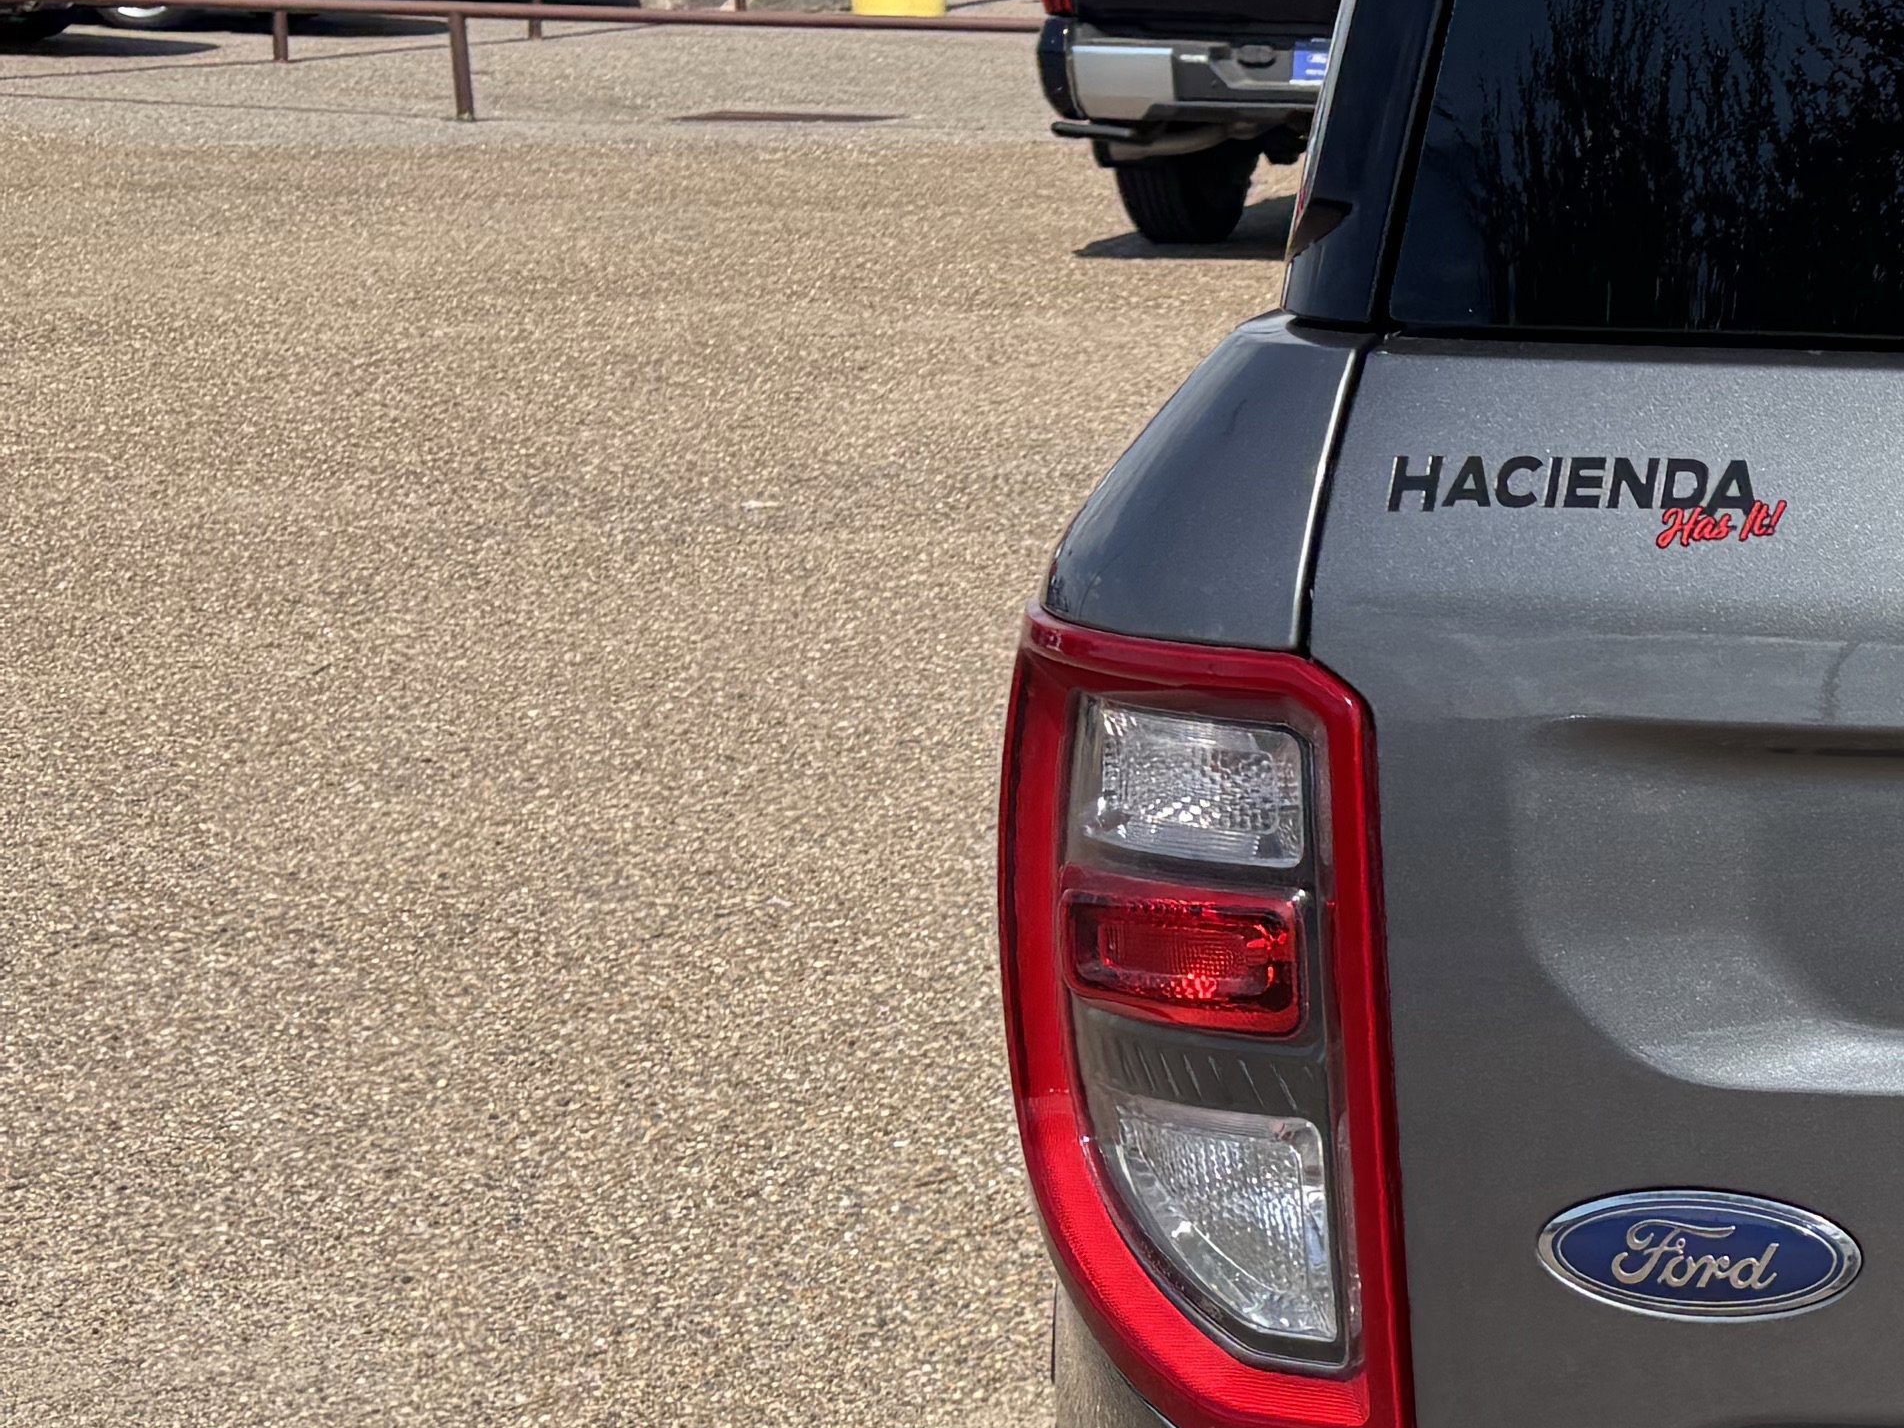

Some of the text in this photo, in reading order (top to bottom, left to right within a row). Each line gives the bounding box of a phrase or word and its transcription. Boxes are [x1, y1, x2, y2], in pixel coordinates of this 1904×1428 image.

[1387, 455, 1757, 516] HACIENDA
[1656, 500, 1788, 549] Has It!
[1611, 1219, 1779, 1290] Ford
